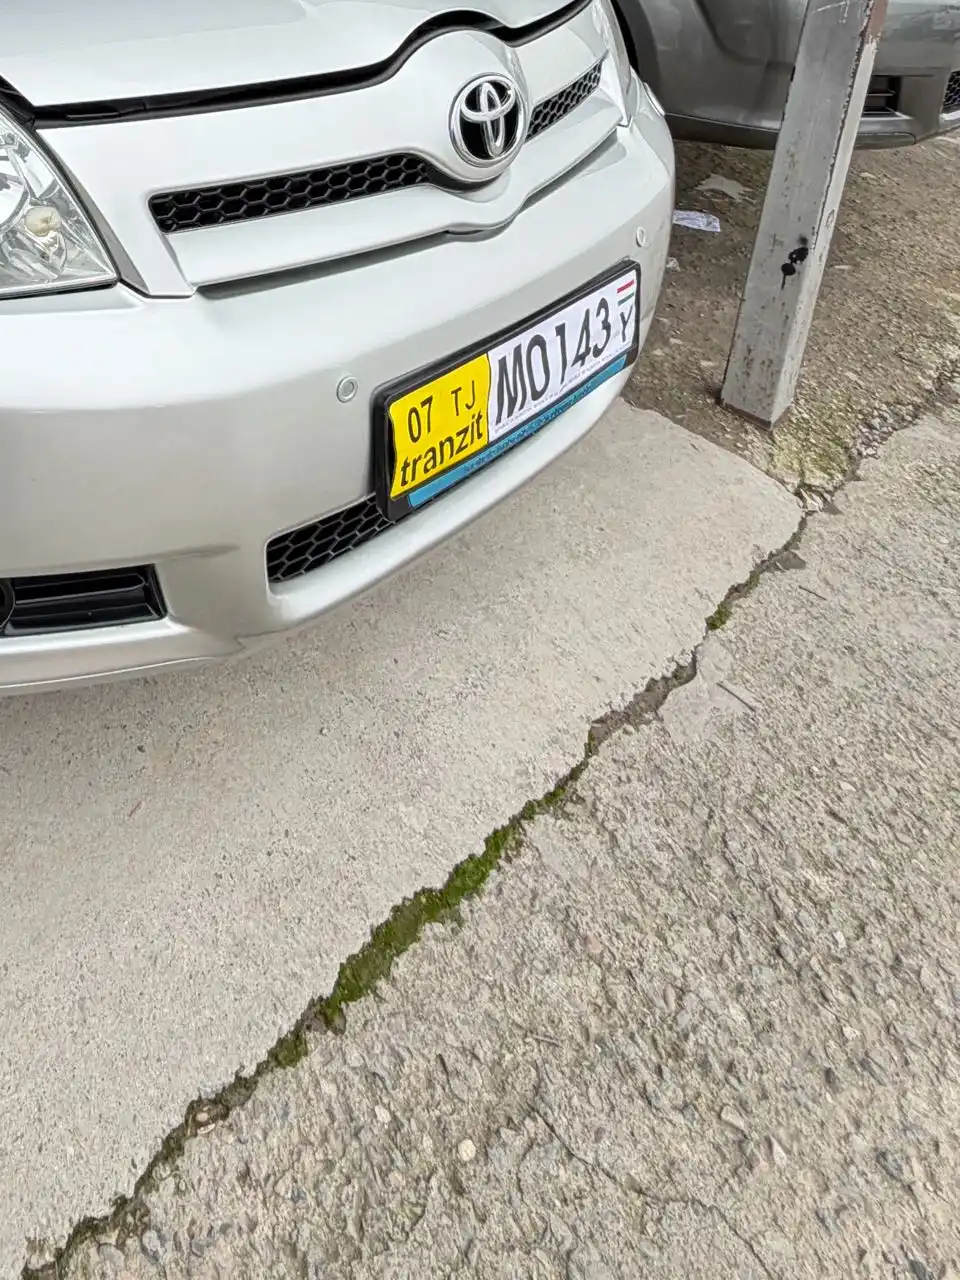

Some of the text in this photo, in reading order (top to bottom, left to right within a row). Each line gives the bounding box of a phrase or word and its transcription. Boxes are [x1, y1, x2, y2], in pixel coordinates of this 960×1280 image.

[619, 305, 634, 343] Y
[407, 395, 434, 443] 07
[451, 380, 476, 417] TJ
[400, 409, 483, 486] tranzit
